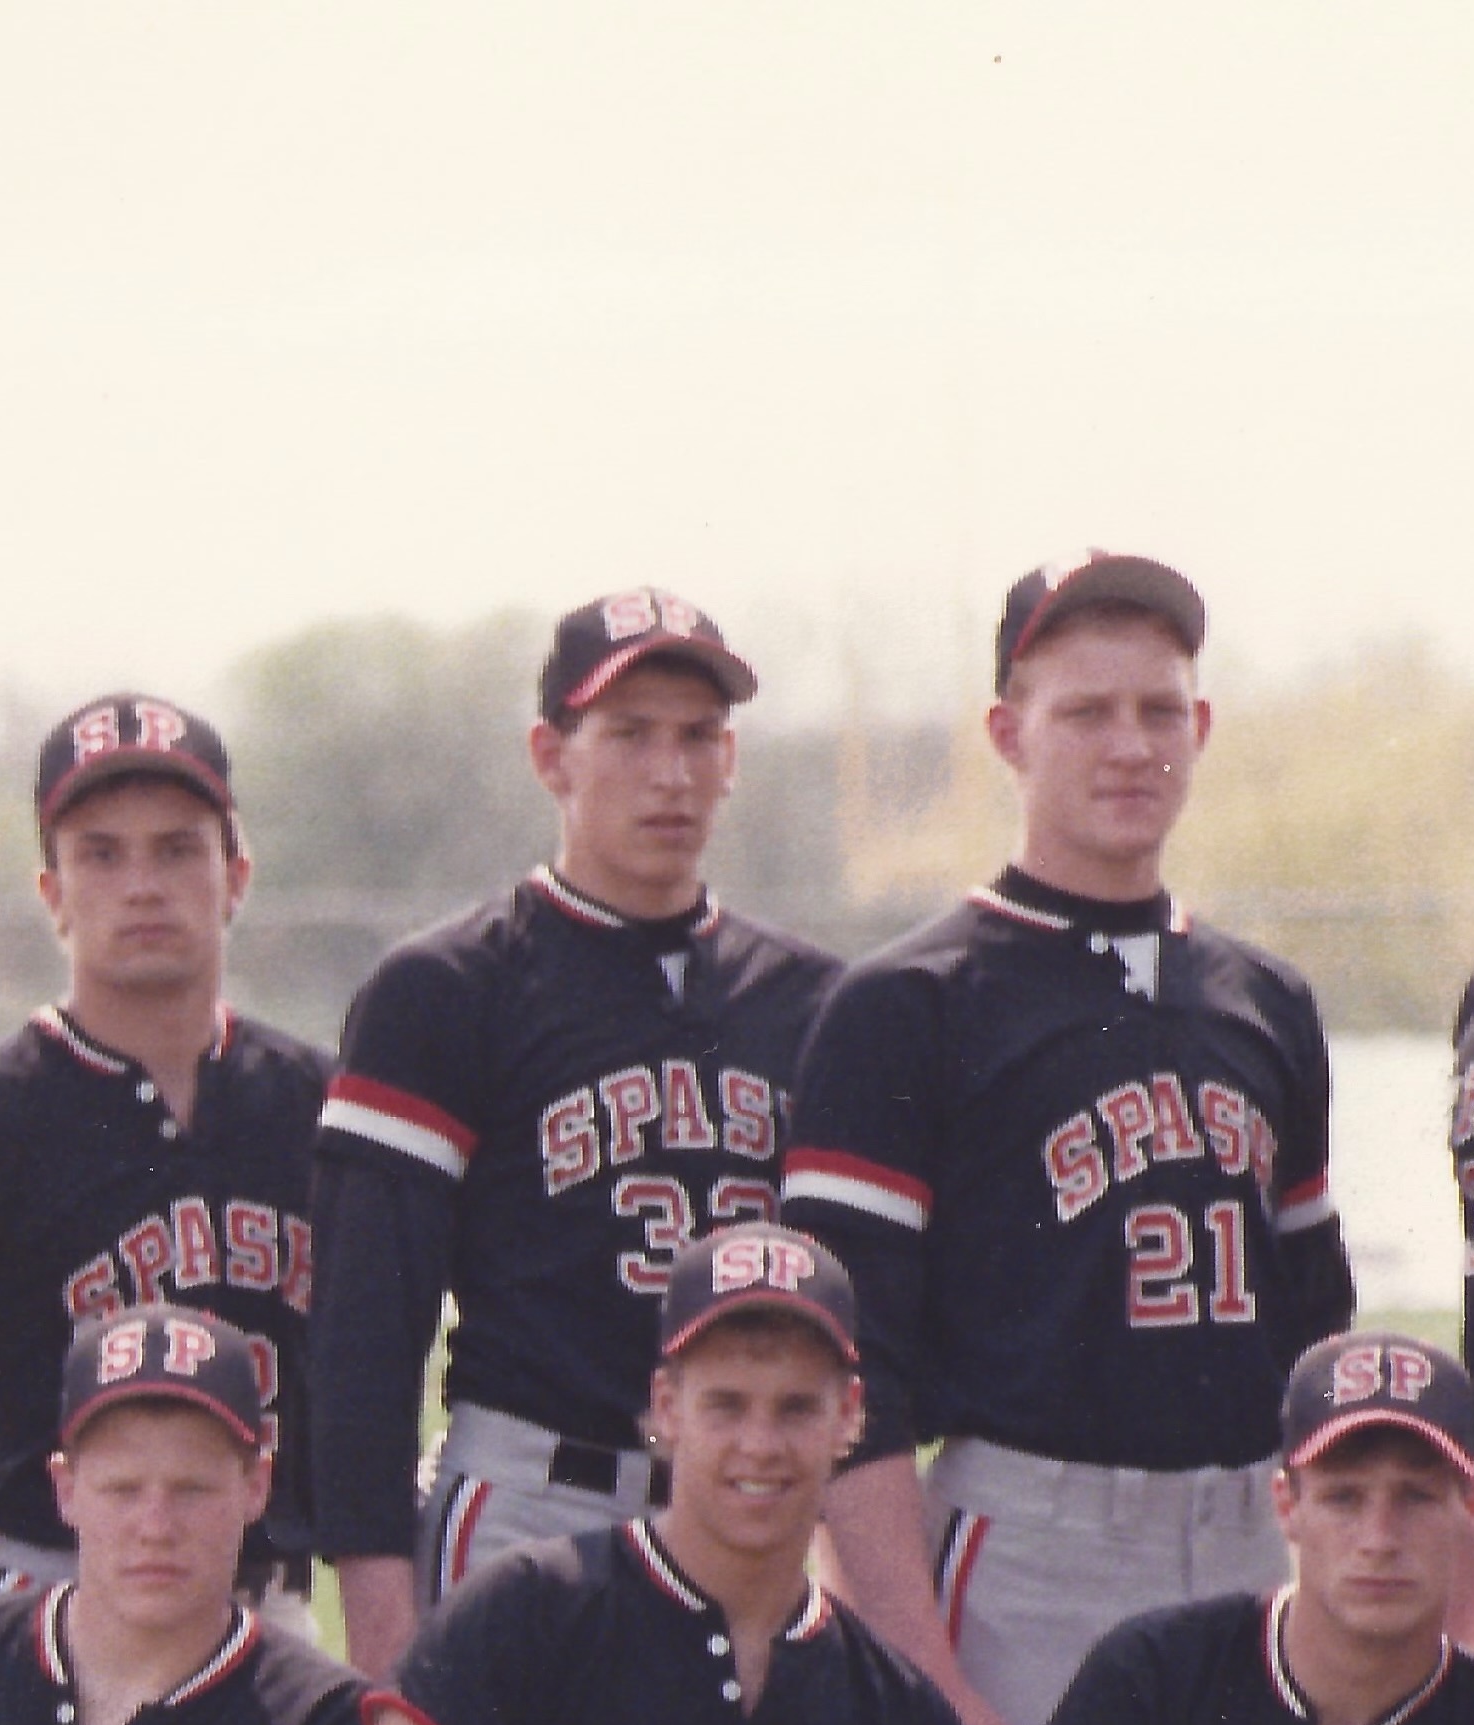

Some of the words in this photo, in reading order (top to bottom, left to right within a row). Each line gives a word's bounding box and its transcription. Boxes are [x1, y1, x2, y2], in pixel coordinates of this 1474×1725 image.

[603, 592, 701, 641] SP
[73, 701, 187, 764] SP
[540, 1058, 792, 1196] SPAS
[1045, 1072, 1279, 1223] SPASH
[711, 1236, 814, 1294] SP
[1128, 1202, 1258, 1328] 21
[99, 1317, 215, 1384] SP
[1334, 1345, 1432, 1403] SP
